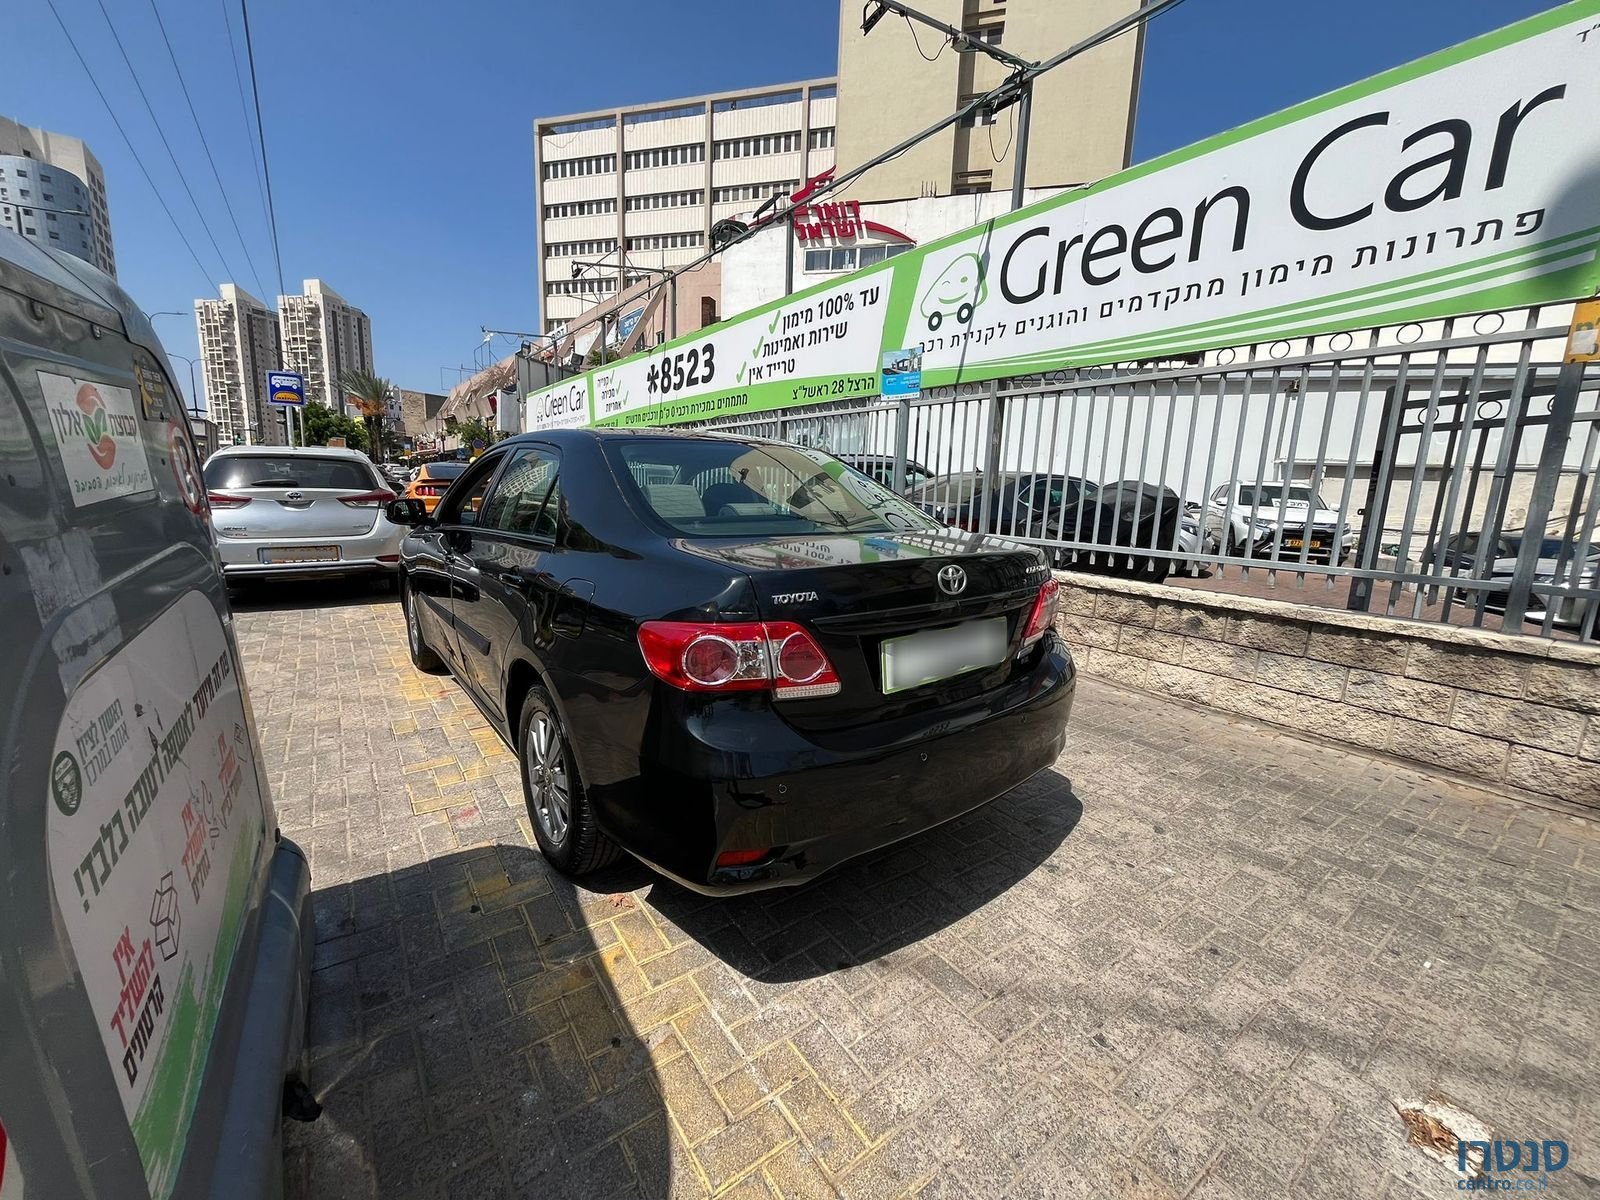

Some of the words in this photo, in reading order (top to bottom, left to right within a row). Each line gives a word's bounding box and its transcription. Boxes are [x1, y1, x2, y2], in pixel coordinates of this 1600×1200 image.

[1000, 185, 1251, 305] Green
[1290, 84, 1567, 232] Car
[809, 200, 860, 221] דואר
[1351, 208, 1546, 269] פתרונות
[1241, 254, 1333, 296] מימון
[818, 292, 855, 319] 100%
[860, 286, 880, 307] עד
[1099, 276, 1225, 319] מתקדמים
[782, 308, 813, 335] מימון
[808, 321, 848, 347] שירות
[1015, 306, 1088, 336] והוגנים
[762, 333, 805, 358] ואמינות
[949, 322, 1007, 349] לקניית
[748, 366, 763, 386] אין
[766, 359, 796, 378] טרייד
[792, 385, 829, 400] ראשל"צ
[831, 380, 845, 395] 28
[847, 377, 875, 392] הרצל
[544, 394, 568, 418] Green
[569, 385, 586, 412] Car
[690, 400, 715, 415] במכירת
[717, 393, 748, 410] מתמחים
[51, 402, 84, 445] אלון
[109, 411, 138, 443] קבוצת
[625, 414, 641, 425] חדשים
[771, 591, 820, 605] TOYOTA
[192, 673, 215, 721] מיועד
[98, 698, 124, 742] ראשון
[76, 720, 100, 766] לציון
[160, 701, 196, 774] לאשפה
[73, 808, 130, 914] בלבד!
[112, 925, 136, 988] אין
[110, 937, 156, 1050] להשליך
[122, 972, 165, 1089] קרטונים
